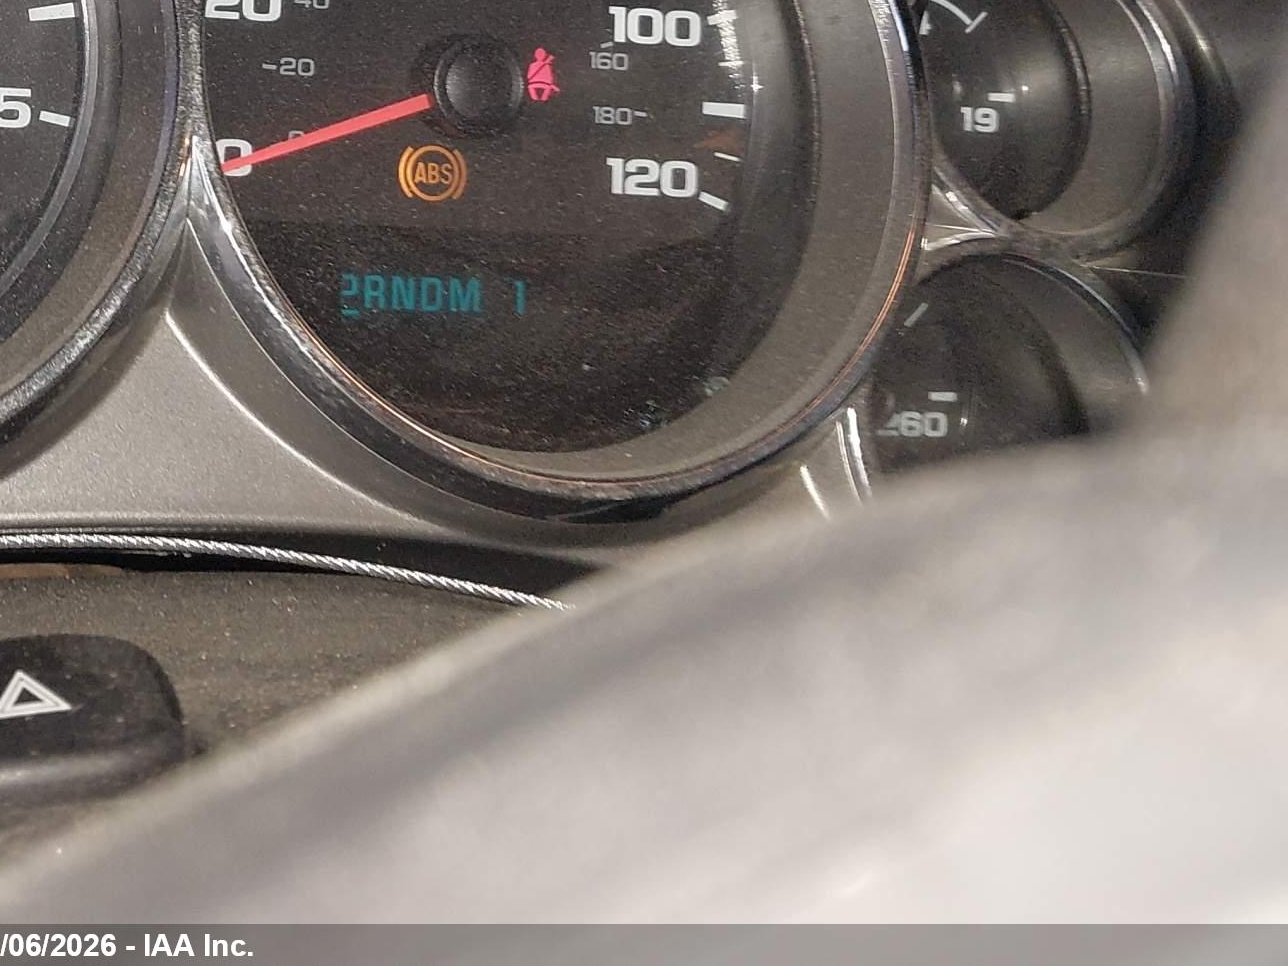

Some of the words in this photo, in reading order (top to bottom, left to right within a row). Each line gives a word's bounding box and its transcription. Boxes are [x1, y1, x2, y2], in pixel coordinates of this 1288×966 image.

[608, 6, 702, 47] 100
[278, 57, 315, 77] 20
[588, 49, 629, 71] 160
[593, 105, 632, 126] 180
[960, 106, 1000, 133] 19
[414, 159, 452, 184] ABS
[606, 157, 698, 198] 120
